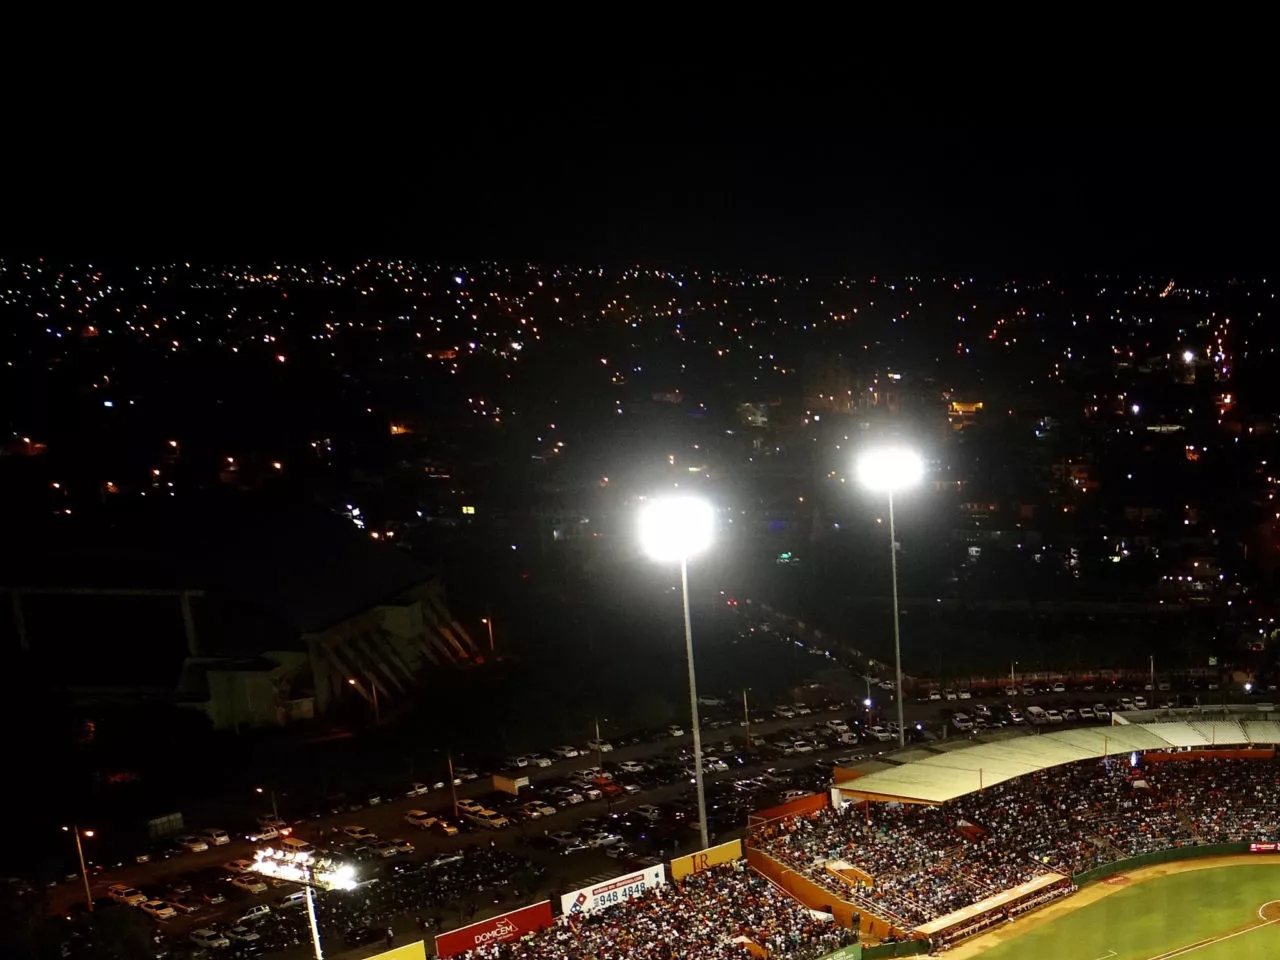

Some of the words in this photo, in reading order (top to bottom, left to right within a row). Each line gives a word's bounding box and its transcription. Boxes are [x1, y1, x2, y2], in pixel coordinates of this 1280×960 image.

[600, 891, 618, 906] 948
[622, 882, 645, 898] 4848
[474, 925, 513, 944] DOMICEM
